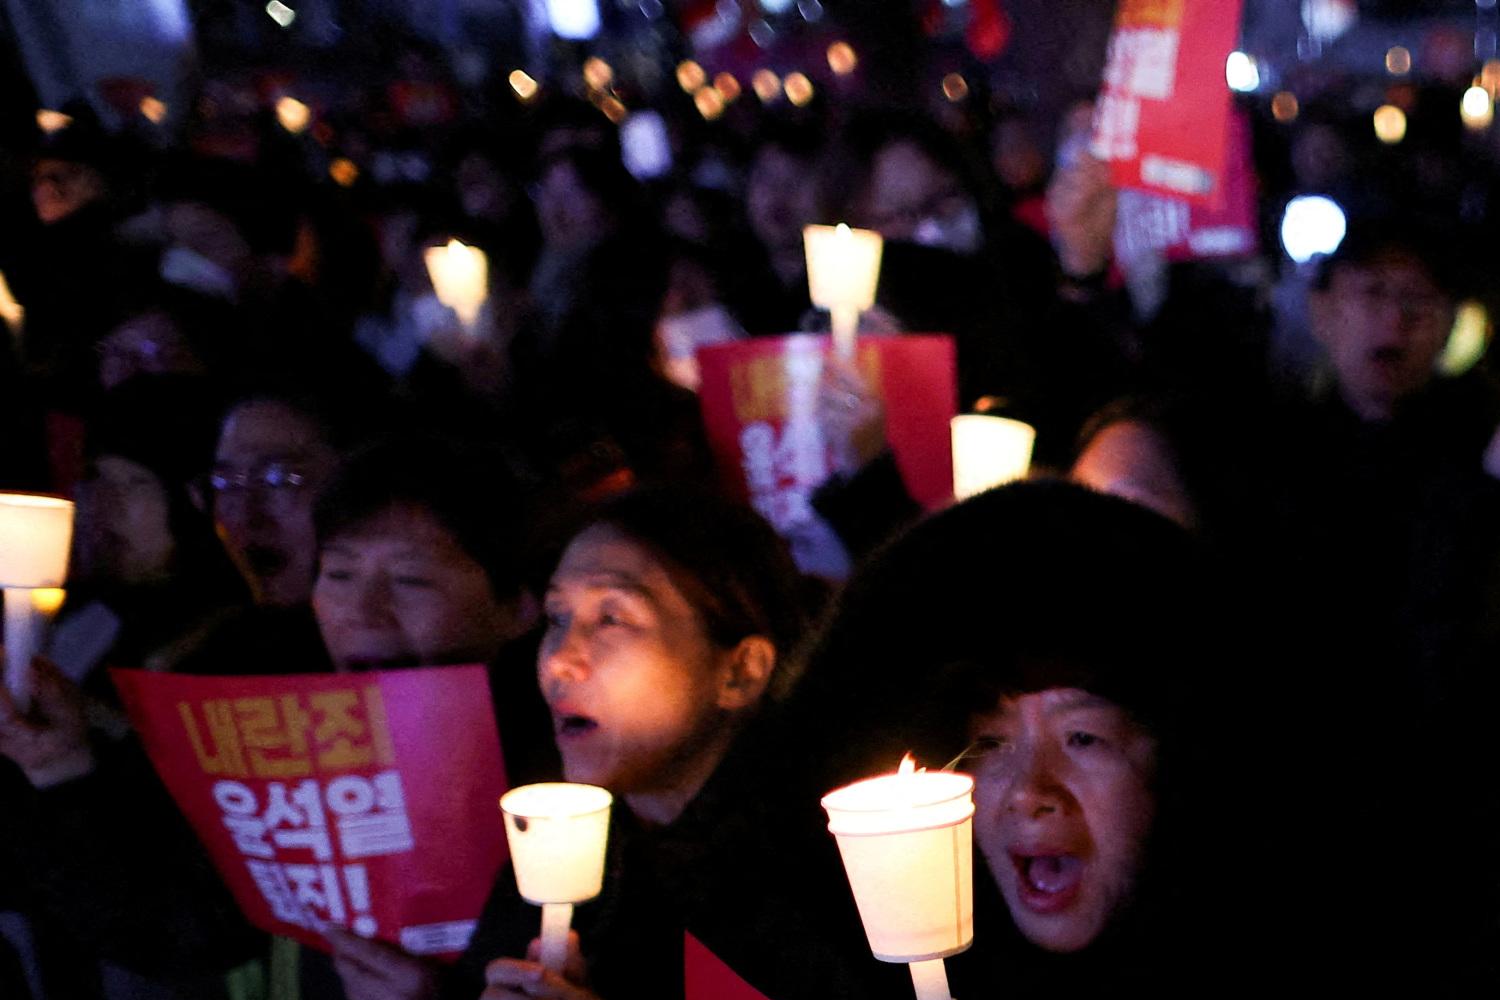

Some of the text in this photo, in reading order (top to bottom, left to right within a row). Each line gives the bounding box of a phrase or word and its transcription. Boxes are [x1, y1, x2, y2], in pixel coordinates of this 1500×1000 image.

[176, 686, 396, 778] 내란죄
[210, 770, 415, 861] 윤석열
[245, 860, 379, 940] 퇴진!
